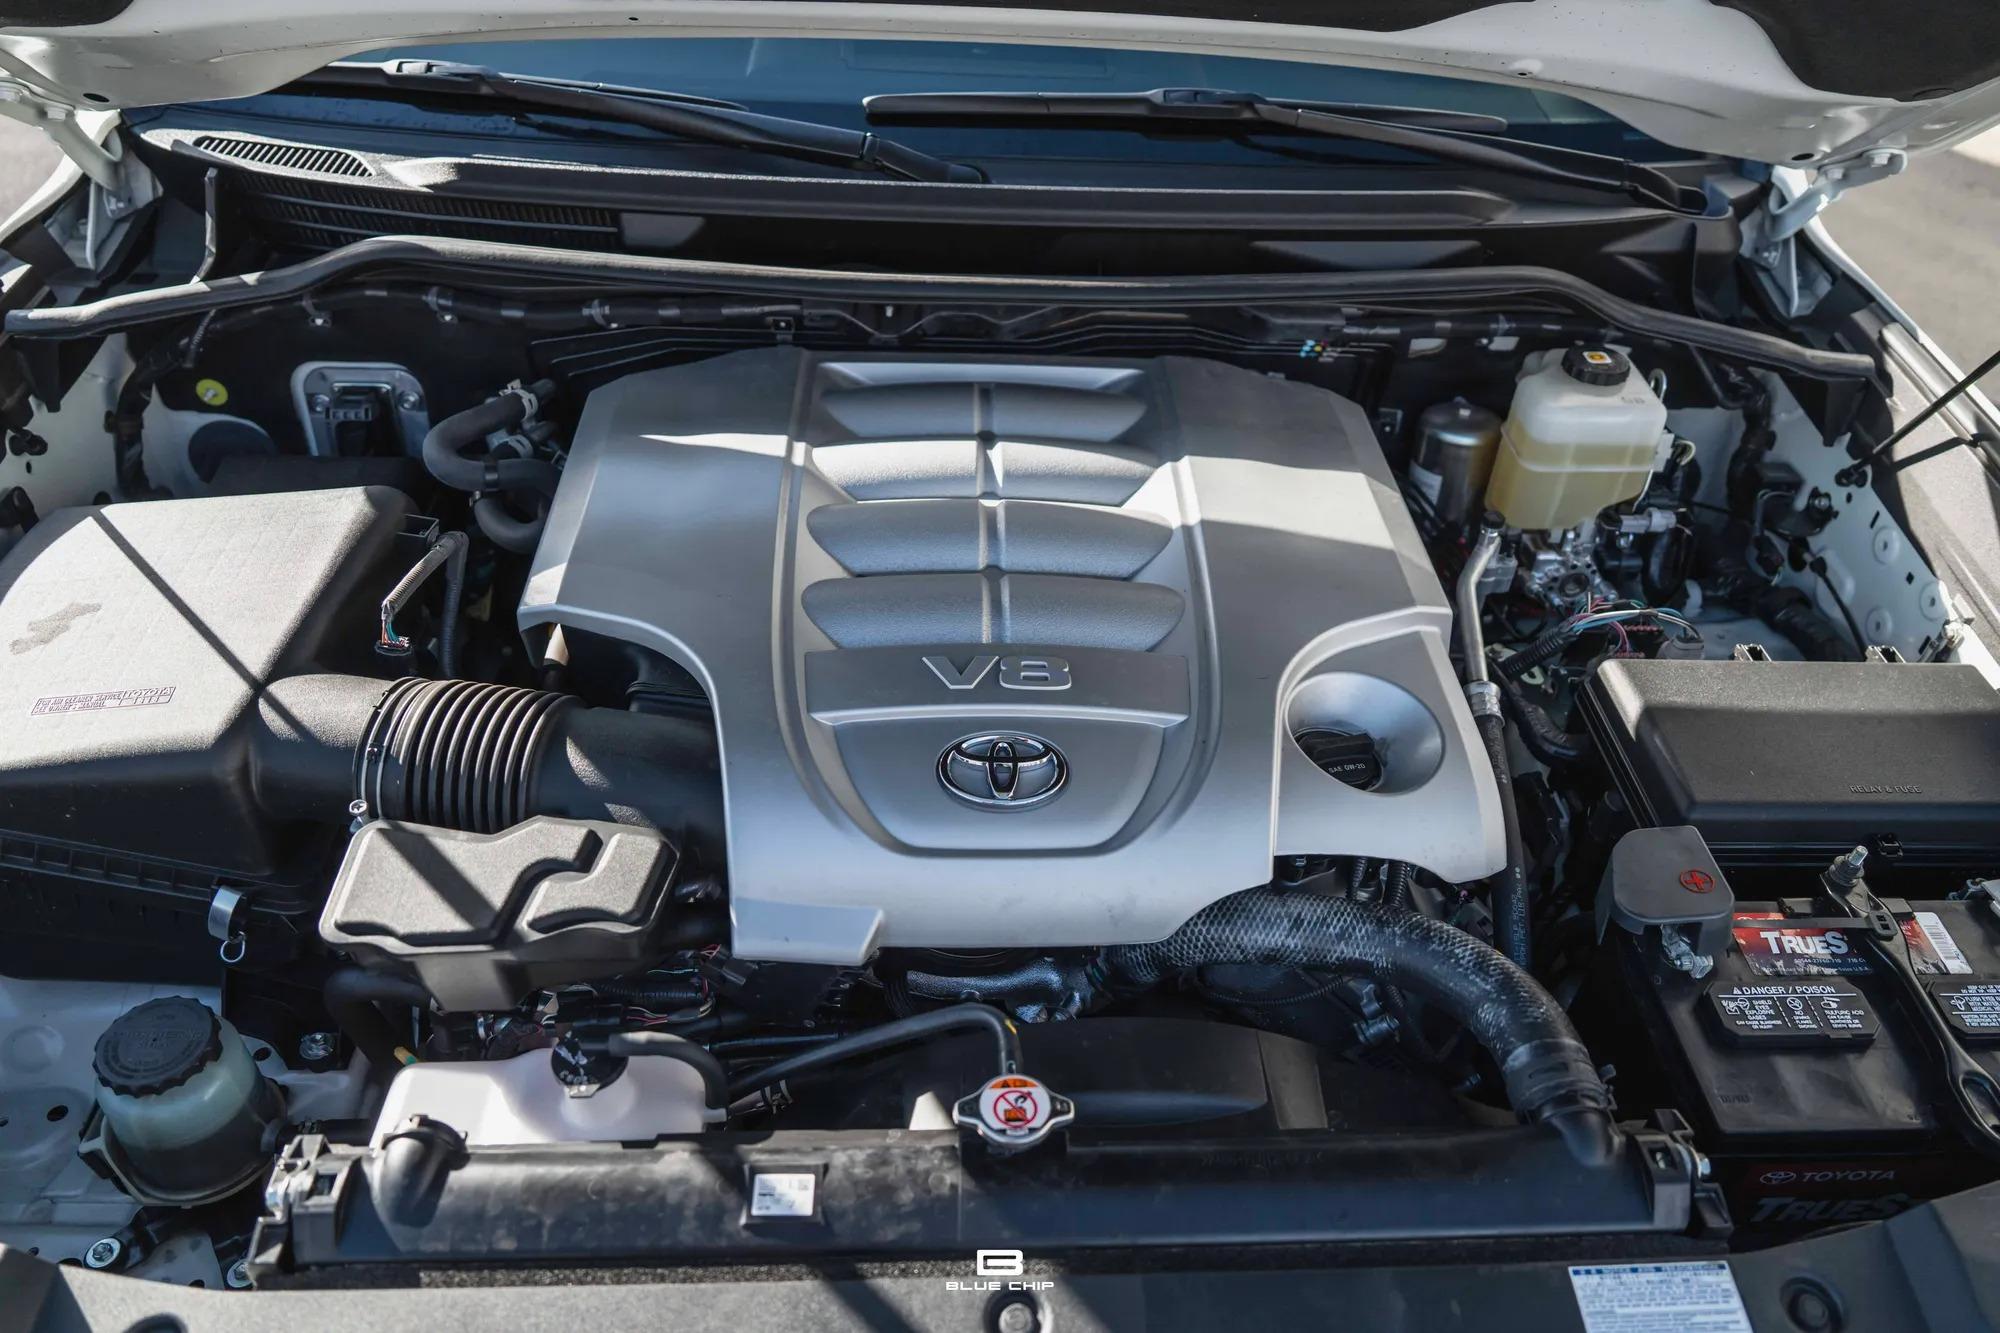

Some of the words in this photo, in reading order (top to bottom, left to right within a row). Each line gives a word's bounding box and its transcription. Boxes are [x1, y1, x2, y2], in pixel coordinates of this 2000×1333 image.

[921, 655, 1072, 691] V8
[125, 687, 170, 698] TOYOTA
[1849, 785, 1882, 794] RELAY
[1894, 784, 1922, 794] FUSE
[1760, 930, 1849, 955] TRUES
[1743, 986, 1787, 995] DANGER
[1795, 985, 1836, 994] POISON
[1801, 1170, 1897, 1182] TOYOTA
